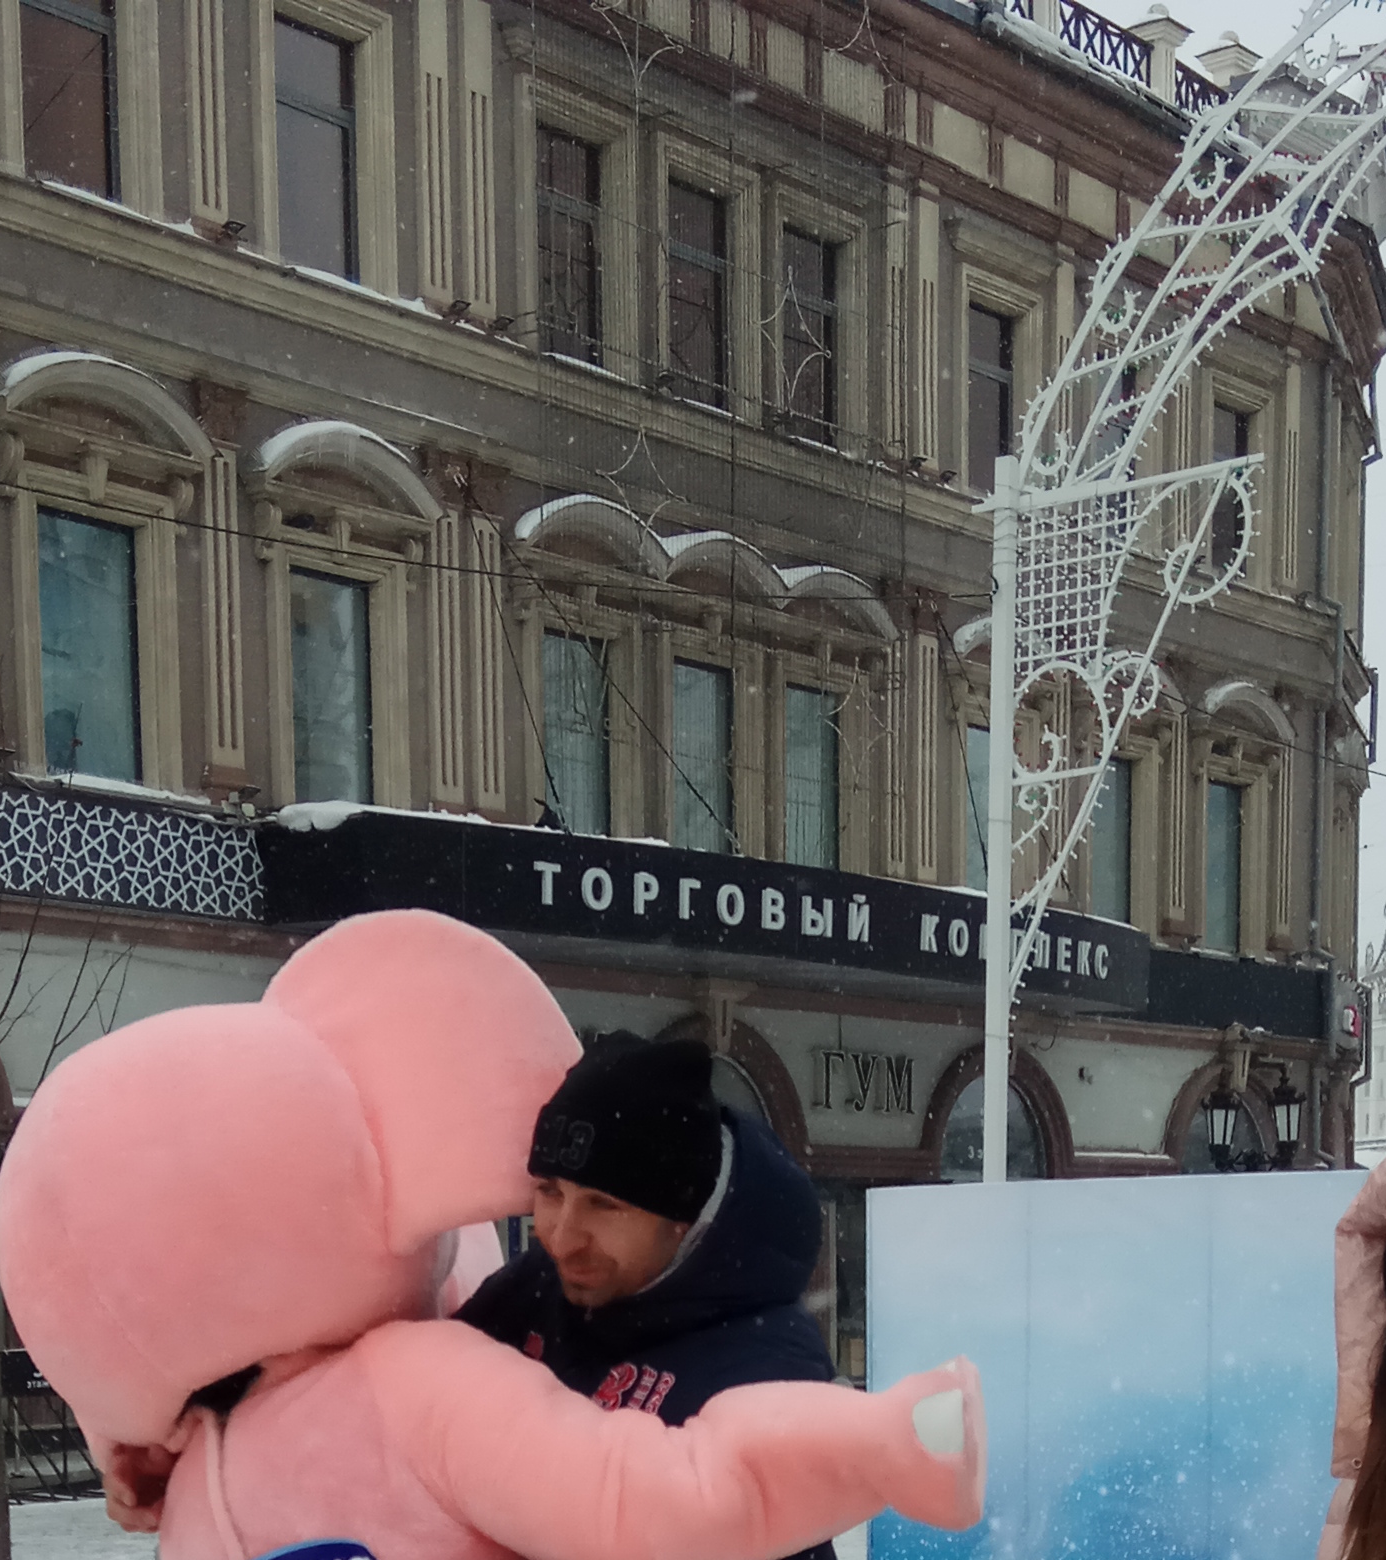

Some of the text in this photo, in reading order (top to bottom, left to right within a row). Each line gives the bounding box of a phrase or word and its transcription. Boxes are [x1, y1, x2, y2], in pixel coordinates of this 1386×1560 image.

[533, 860, 1109, 980] ТОРГОВЫЙ КОПЛЕКС
[821, 1050, 915, 1115] ГУМ
